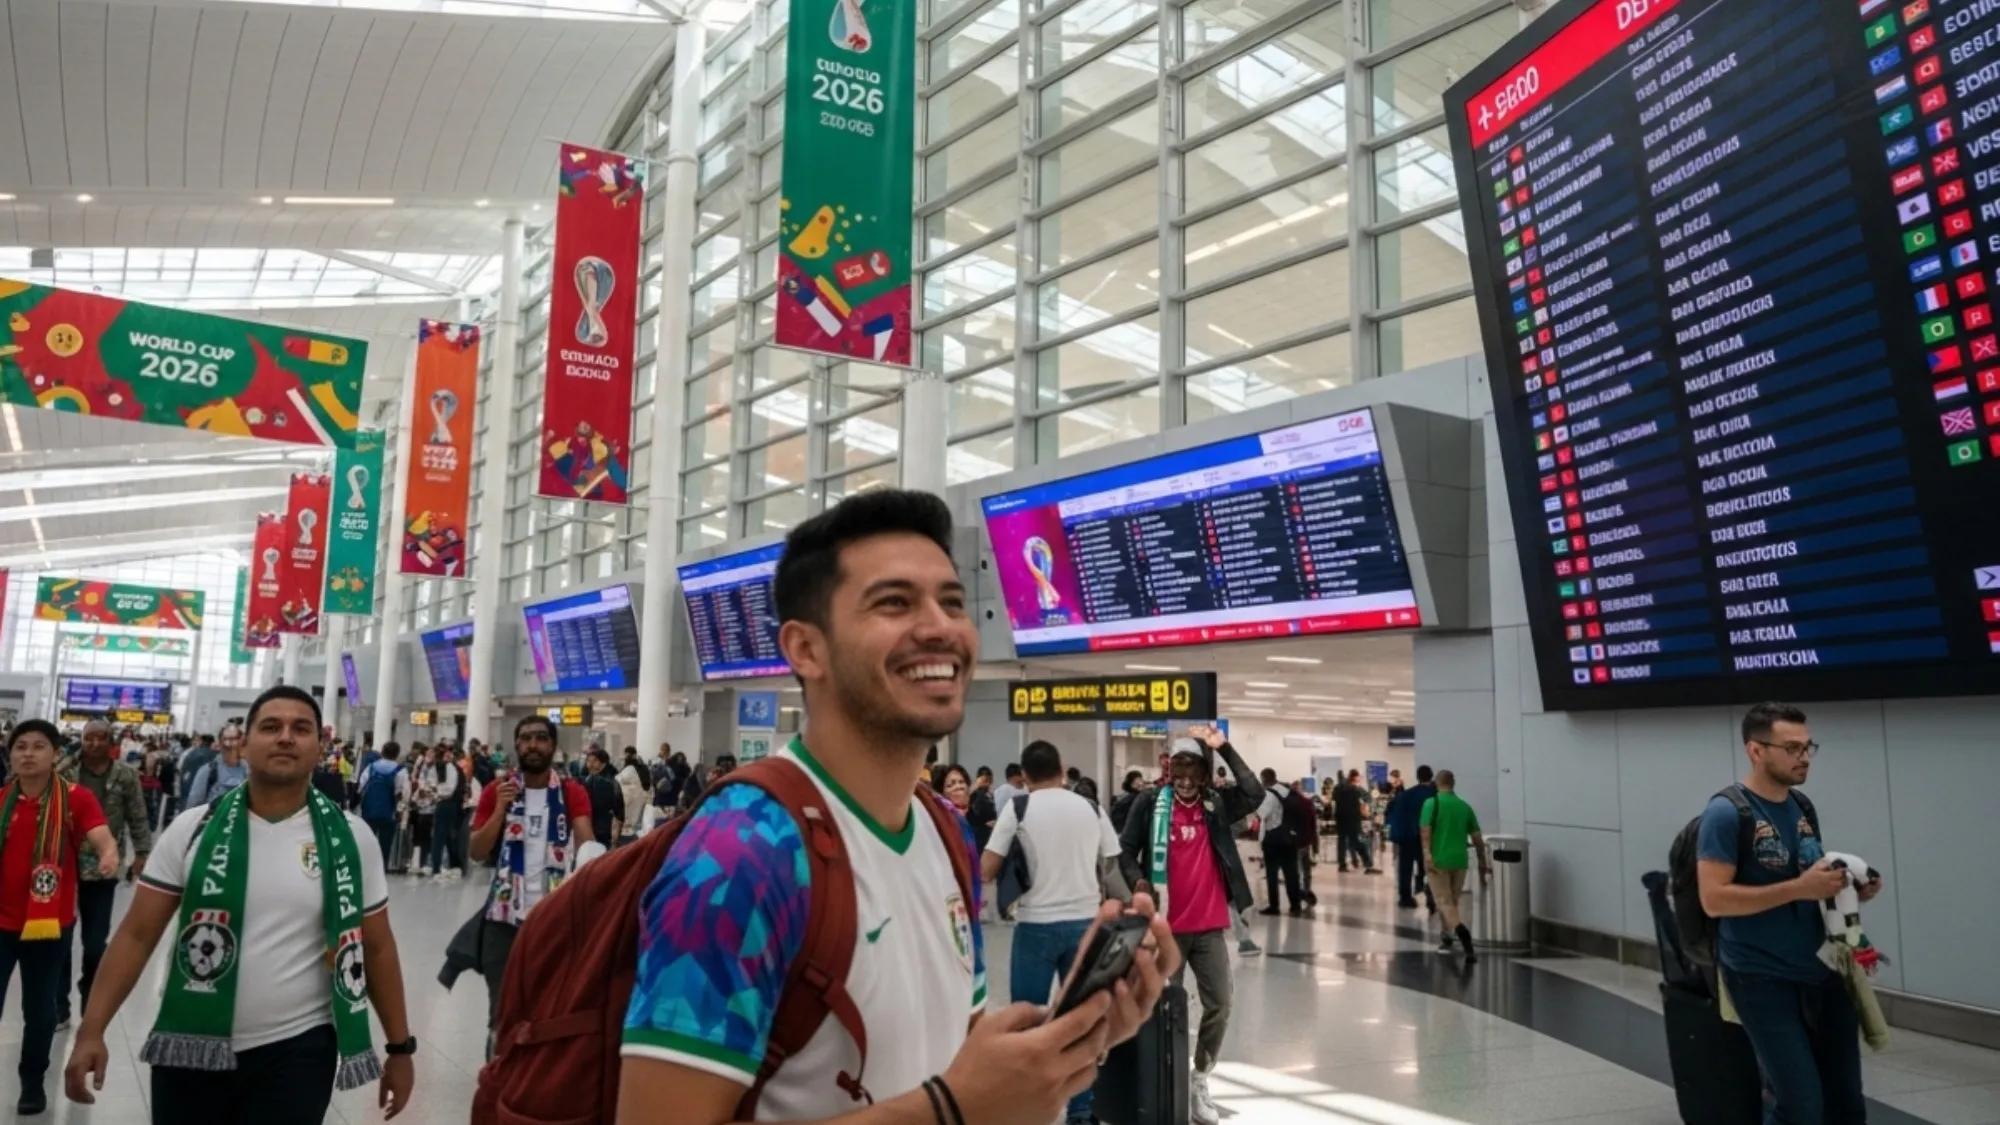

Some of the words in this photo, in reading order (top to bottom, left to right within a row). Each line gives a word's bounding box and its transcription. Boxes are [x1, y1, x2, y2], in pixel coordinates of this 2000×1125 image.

[812, 73, 884, 115] 2026
[129, 331, 196, 355] WORLD
[199, 343, 235, 360] CUP
[140, 351, 219, 387] 2026
